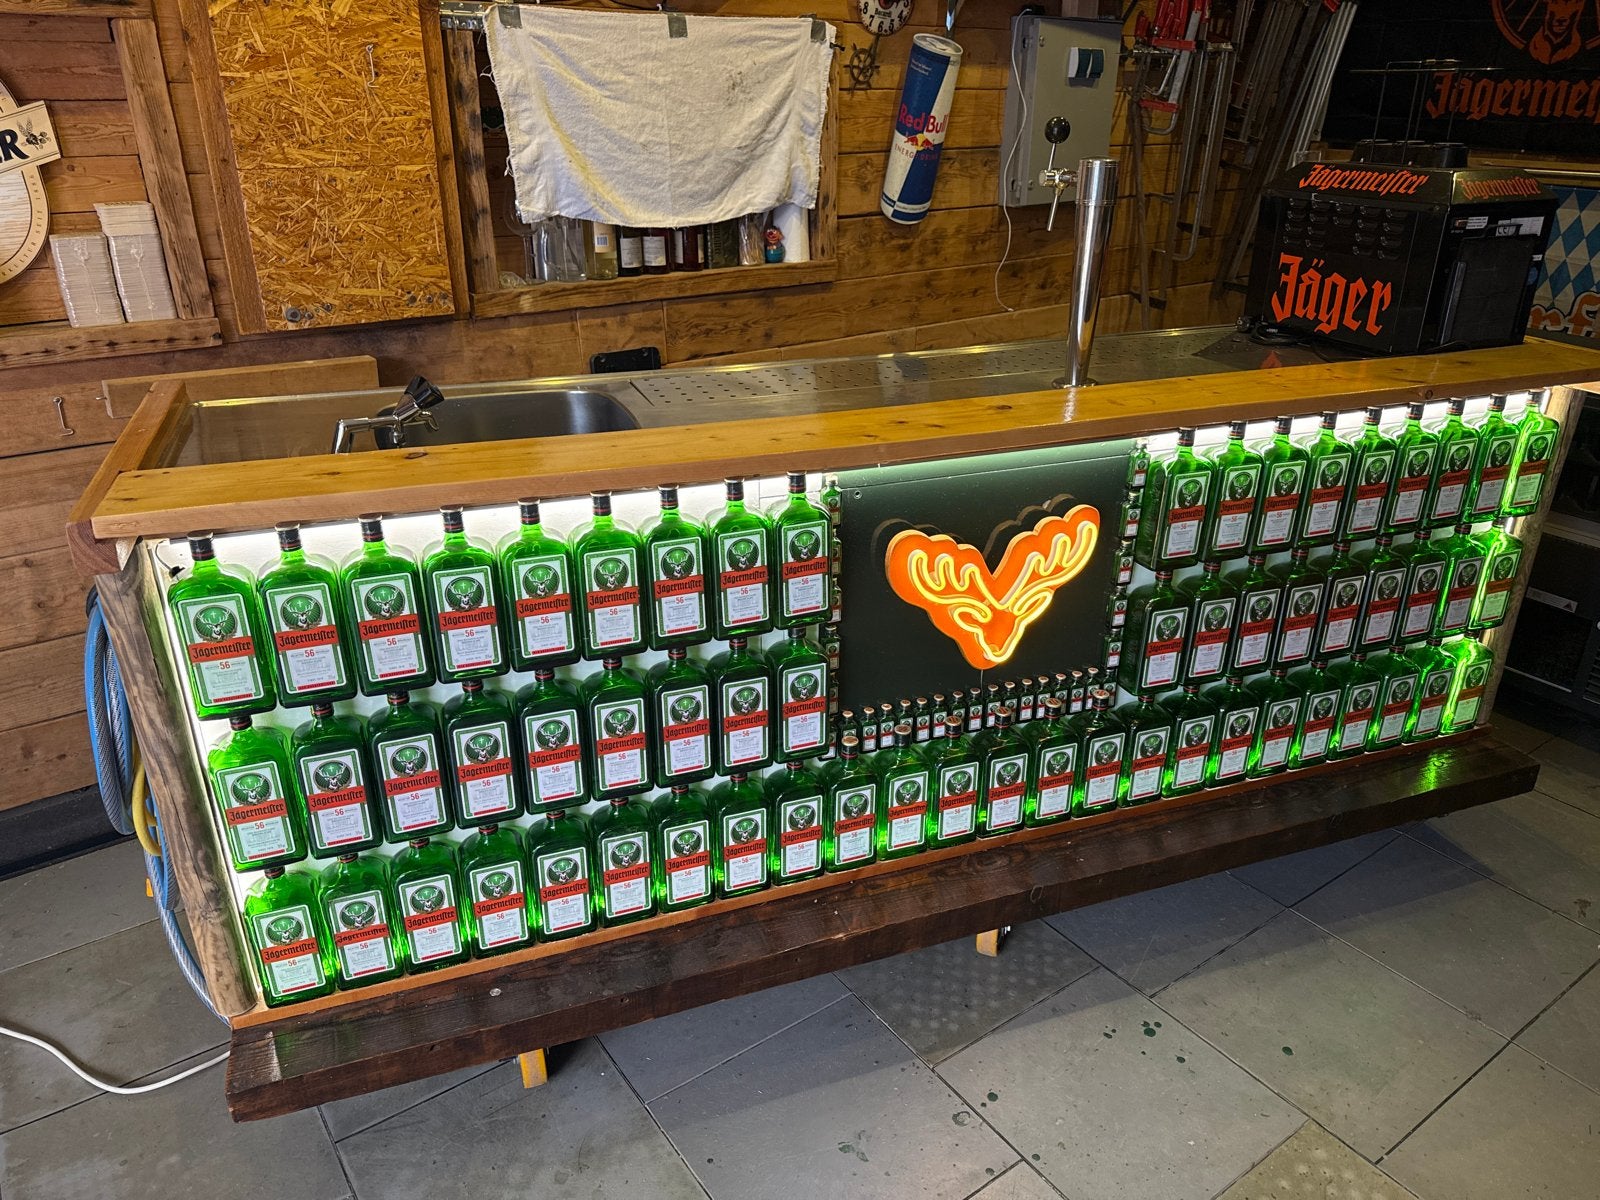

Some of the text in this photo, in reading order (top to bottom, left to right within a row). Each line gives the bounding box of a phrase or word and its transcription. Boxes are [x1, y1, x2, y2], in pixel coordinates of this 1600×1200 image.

[863, 2, 869, 14] 8
[869, 15, 874, 27] 7
[878, 21, 883, 32] 6
[889, 19, 894, 32] 5
[899, 103, 948, 134] Red Bull
[1298, 163, 1430, 196] Jägermeister
[1458, 176, 1542, 201] Jägermeister
[1270, 252, 1392, 337] Jäger
[784, 561, 826, 576] Jägermeister
[723, 570, 766, 586] Jägermeister
[657, 579, 702, 595] Jägermeister
[519, 598, 569, 614] Jägermeister
[590, 591, 637, 606] Jägermeister
[442, 611, 494, 627] Jägermeister
[540, 616, 549, 624] 56
[362, 618, 417, 637] Jägermeister
[465, 629, 474, 637] 56
[279, 628, 336, 647] Jägermeister
[387, 637, 397, 646] 56
[193, 640, 251, 659] Jägermeister
[304, 649, 315, 658] 56
[220, 660, 230, 670] 56
[784, 700, 824, 715] Jägermeister
[726, 713, 766, 729] Jägermeister
[666, 723, 708, 739] Jägermeister
[599, 737, 644, 753] Jägermeister
[532, 749, 578, 765] Jägermeister
[461, 762, 510, 778] Jägermeister
[388, 774, 438, 792] Jägermeister
[311, 790, 364, 808] Jägermeister
[410, 792, 419, 801] 56
[230, 804, 284, 822] Jägermeister
[335, 808, 344, 816] 56
[889, 803, 926, 817] Jägermeister
[255, 821, 265, 830] 56
[837, 817, 873, 831] Jägermeister
[783, 828, 821, 844] Jägermeister
[725, 842, 765, 857] Jägermeister
[668, 854, 708, 870] Jägermeister
[606, 866, 648, 882] Jägermeister
[543, 882, 587, 898] Jägermeister
[477, 897, 523, 914] Jägermeister
[407, 910, 455, 928] Jägermeister
[496, 912, 505, 920] 56
[337, 926, 386, 942] Jägermeister
[265, 942, 315, 960] Jägermeister
